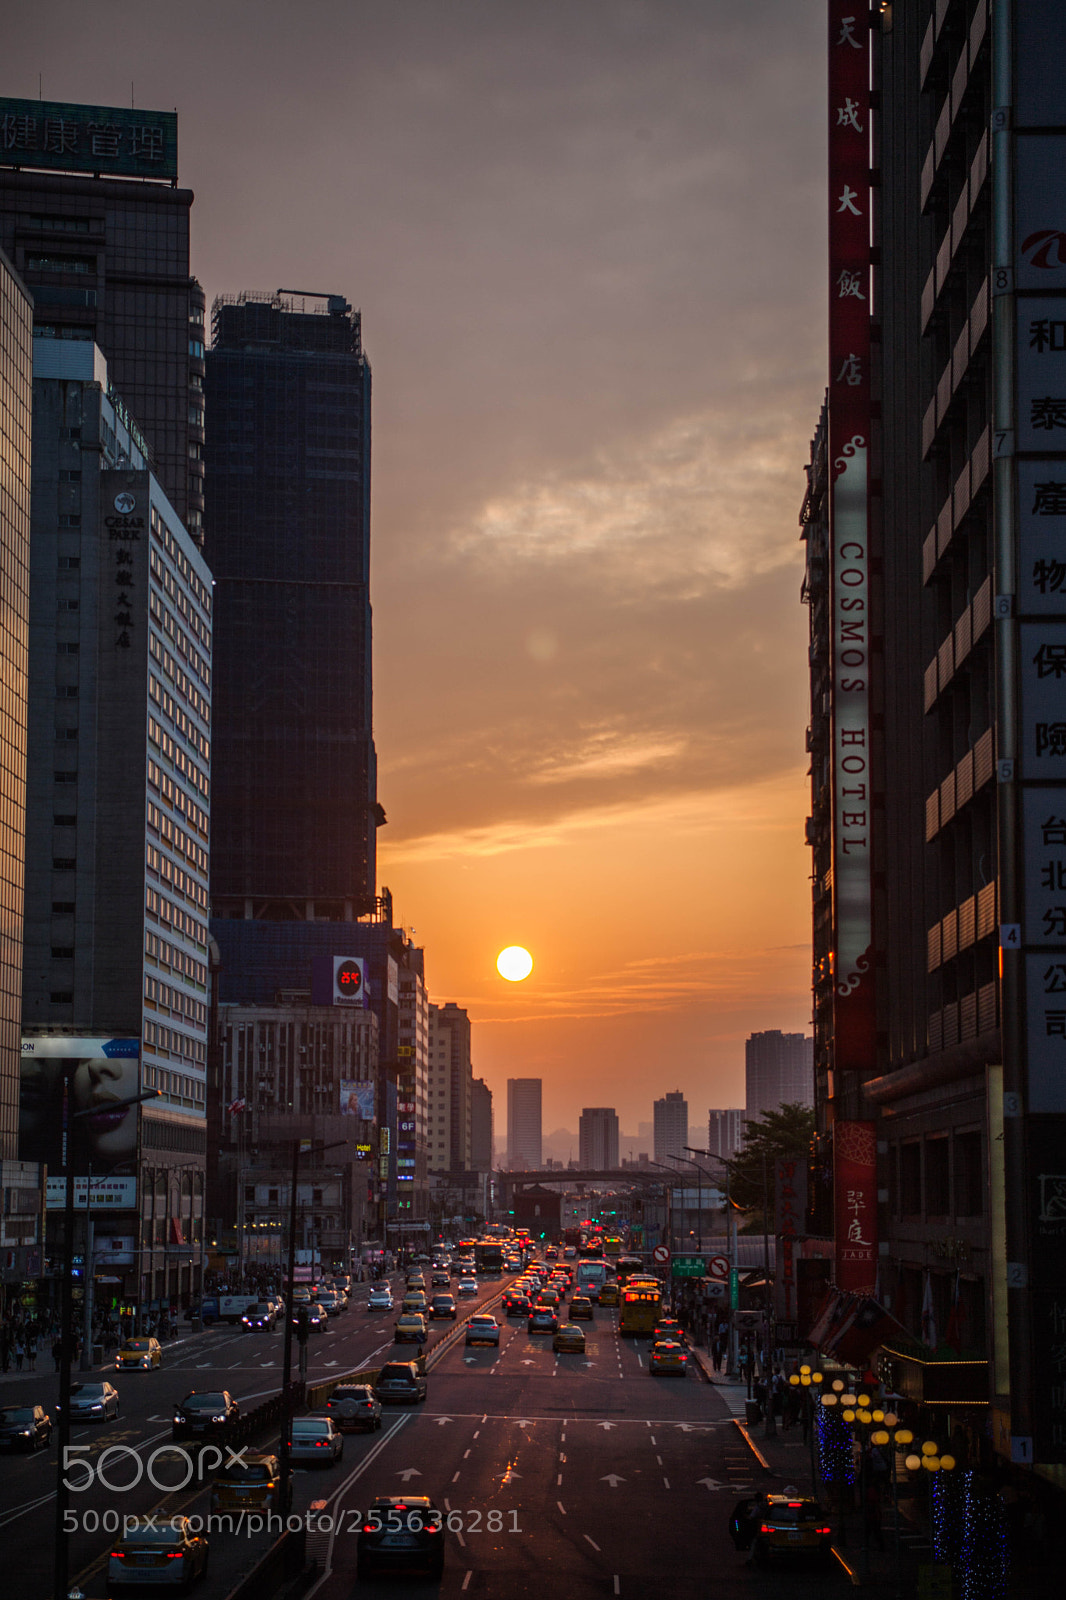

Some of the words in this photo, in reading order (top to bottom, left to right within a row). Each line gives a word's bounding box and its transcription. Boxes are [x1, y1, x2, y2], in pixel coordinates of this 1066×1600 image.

[1, 113, 165, 161] 健康管理
[835, 16, 867, 387] 天成大飯店
[996, 270, 1008, 289] 8
[996, 433, 1007, 453] 7
[108, 528, 141, 541] PARK
[840, 542, 865, 692] COSMOS
[1002, 764, 1012, 778] 5
[841, 728, 867, 855] HOTEL
[1007, 928, 1017, 943] 4
[401, 1122, 415, 1131] 6F
[356, 1143, 372, 1152] Hotel
[846, 1190, 873, 1246] 翠庭
[843, 1251, 873, 1259] JADE
[1019, 1441, 1028, 1458] 1
